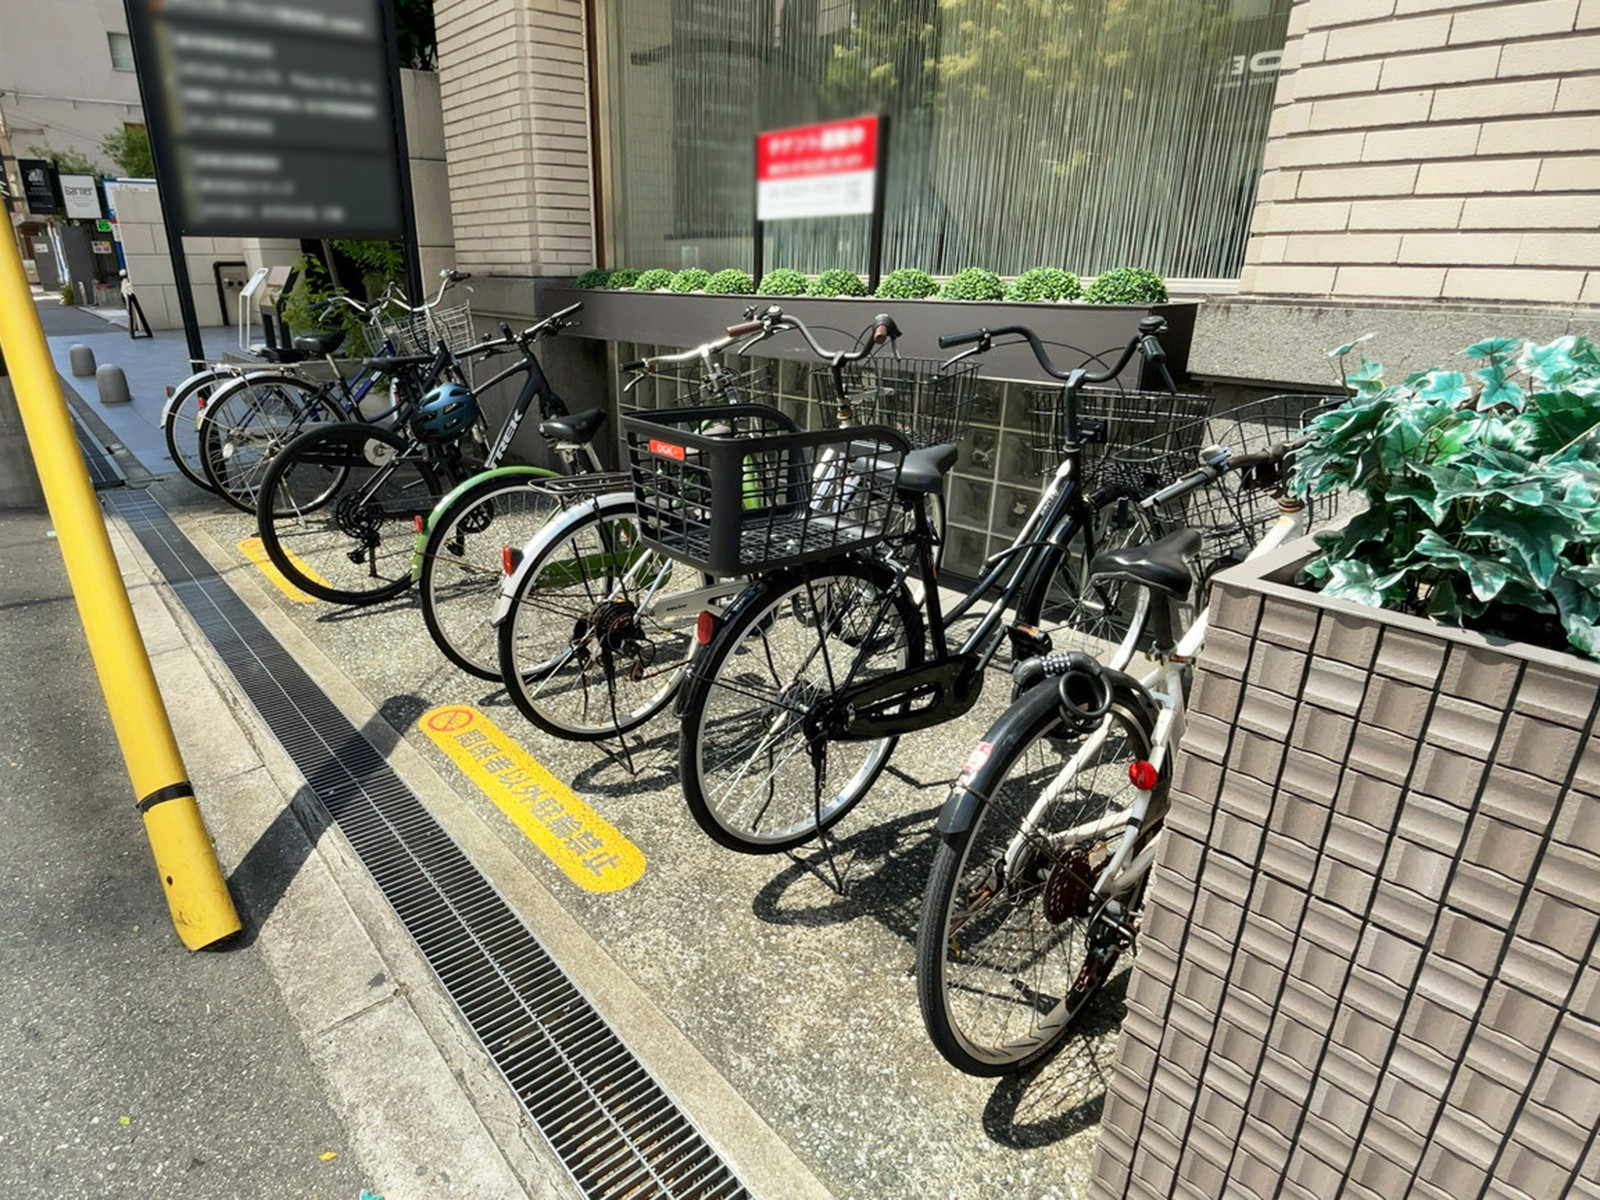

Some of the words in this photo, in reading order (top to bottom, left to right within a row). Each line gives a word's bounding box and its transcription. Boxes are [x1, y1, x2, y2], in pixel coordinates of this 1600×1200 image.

[65, 186, 93, 196] Garner
[489, 409, 523, 469] TREK
[453, 728, 623, 877] 関係者以外駐輪禁止
